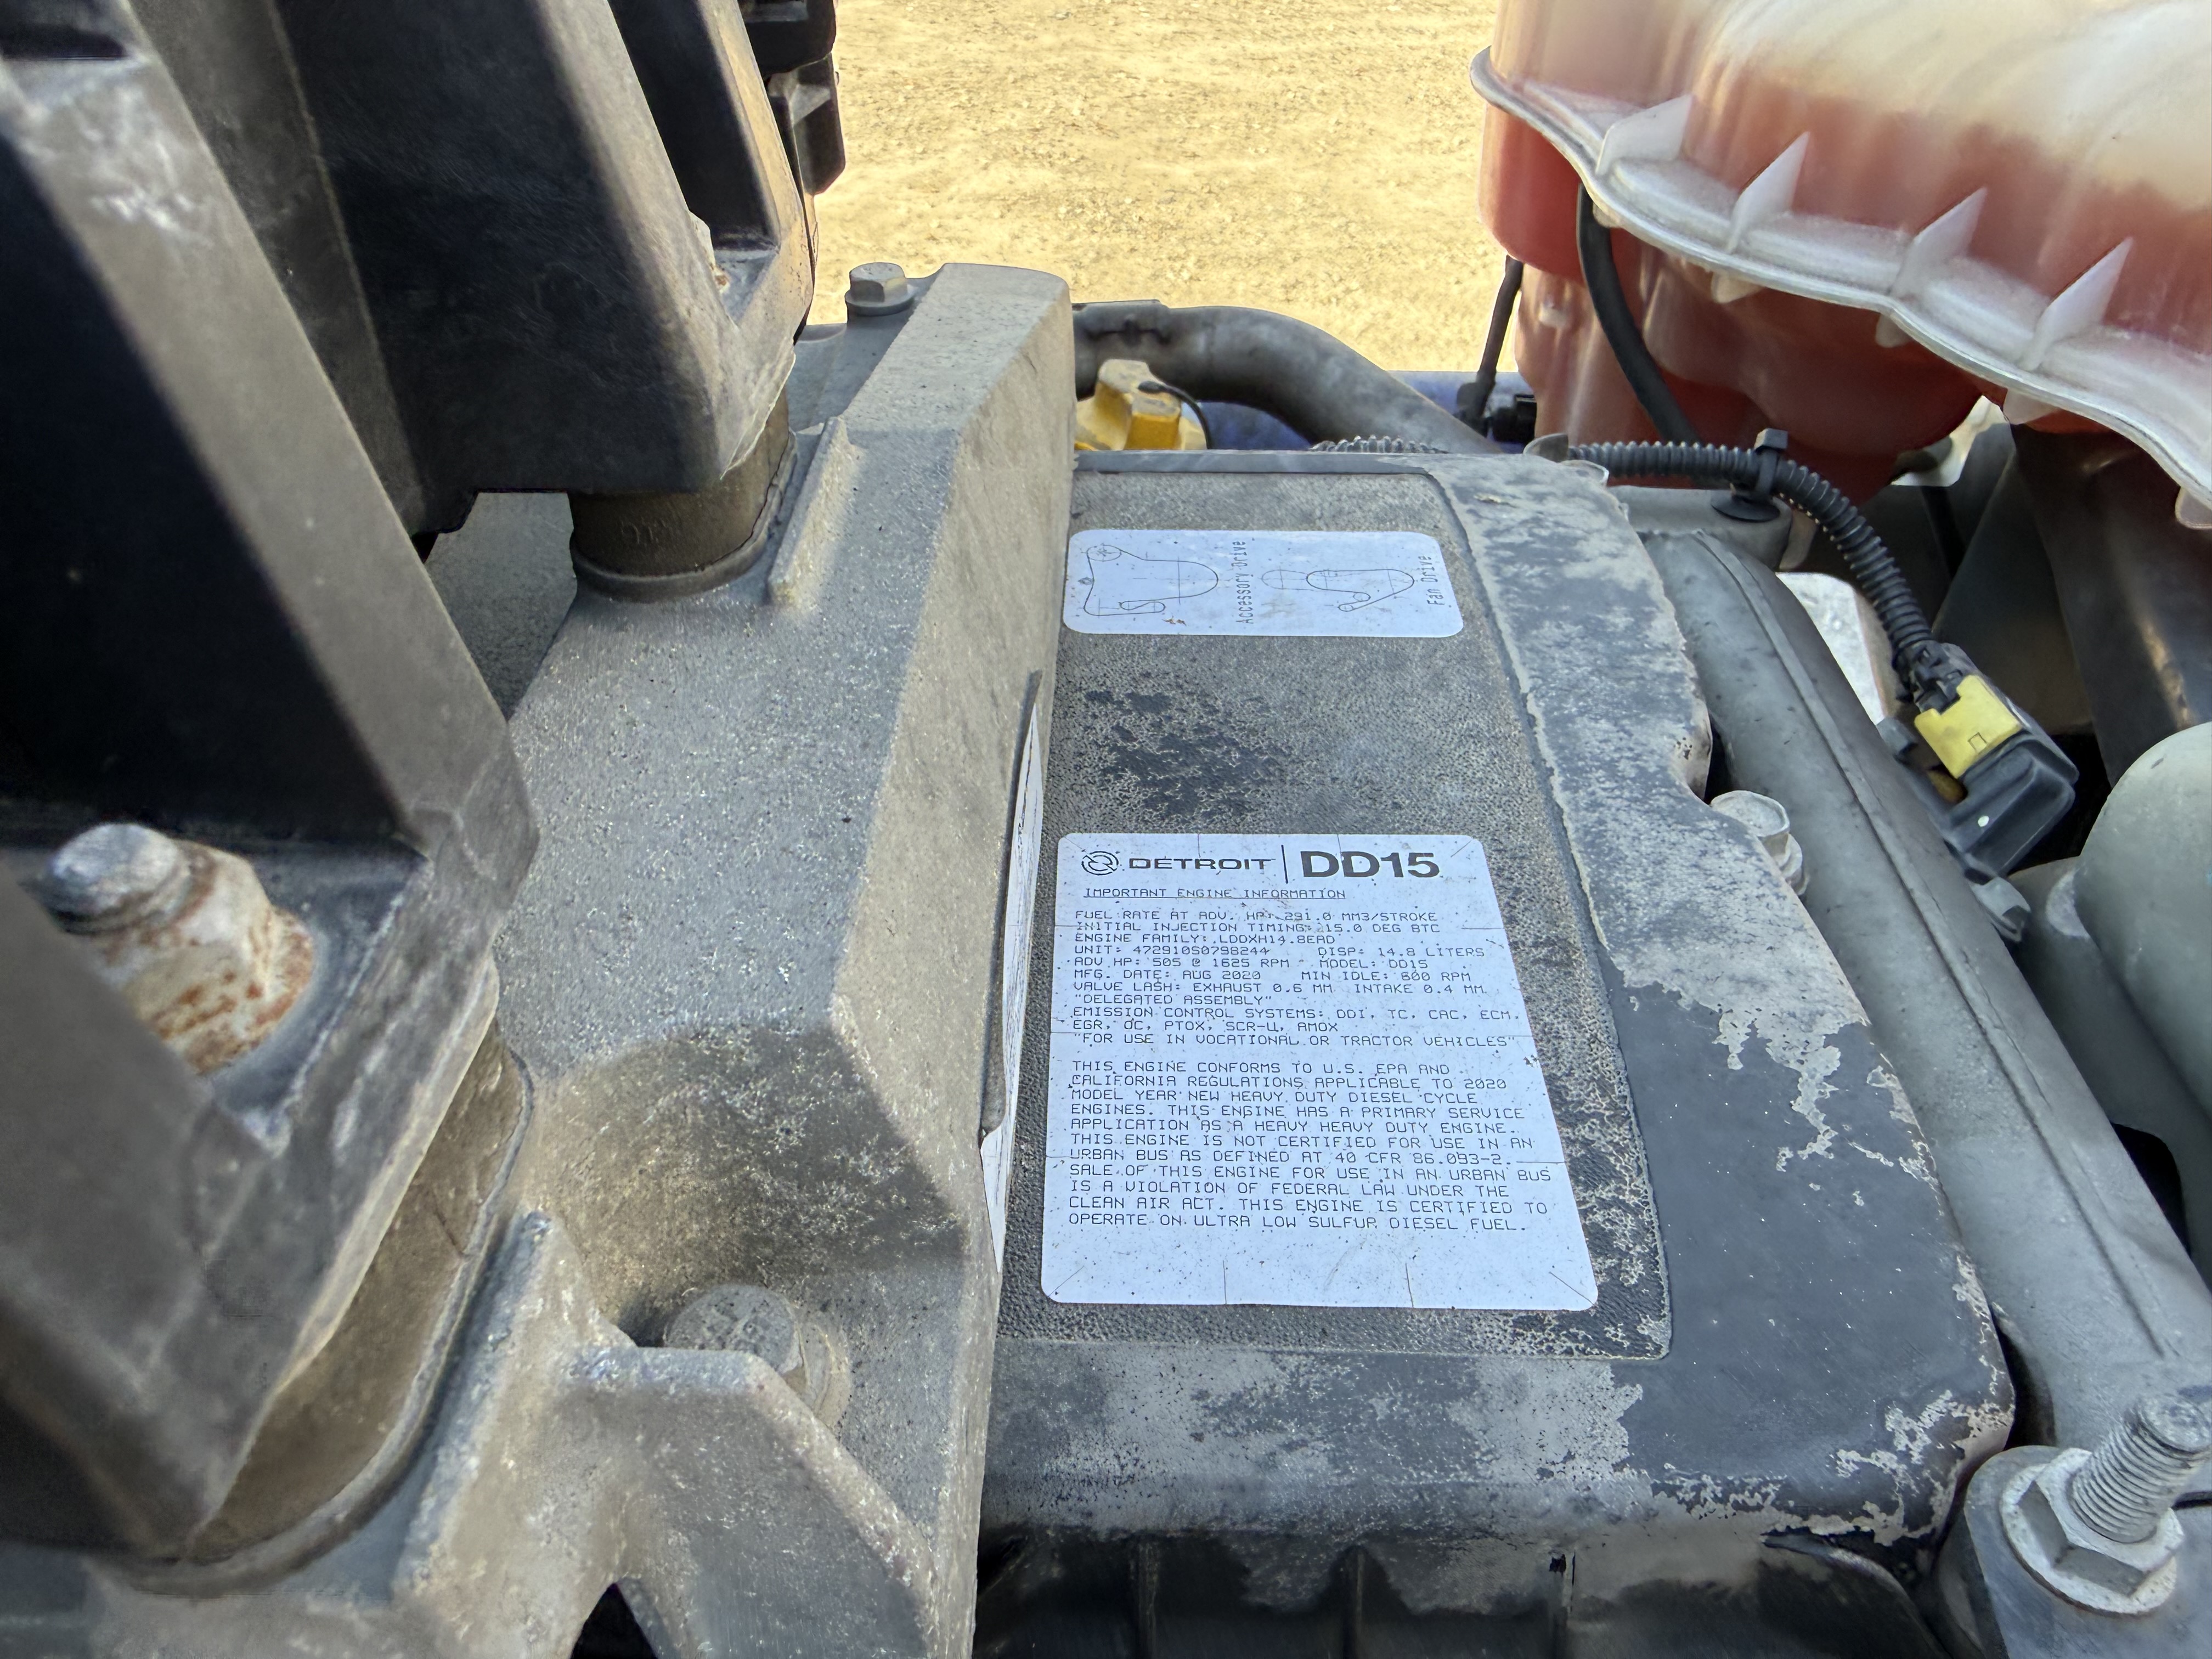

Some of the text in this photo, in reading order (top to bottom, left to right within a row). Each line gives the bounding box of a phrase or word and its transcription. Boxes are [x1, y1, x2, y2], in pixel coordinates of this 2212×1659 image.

[1231, 541, 1254, 624] Accessory Drive
[1418, 555, 1445, 605] Fan Drive
[1129, 858, 1273, 870] DETROIT
[1300, 851, 1440, 878] DD15
[1085, 888, 1345, 899] IMPORTANT ENGINE INFORMATION
[1075, 910, 1113, 919] FUEL
[1123, 911, 1160, 919] RATE
[1170, 911, 1188, 920] AT
[1199, 911, 1234, 920] ADV.
[1285, 912, 1331, 921] 291.0
[1342, 912, 1438, 921] MM3/STROKE
[1076, 922, 1141, 930] INITIAL
[1154, 922, 1237, 931] INJECTION
[1326, 924, 1362, 933] 15.0
[1373, 924, 1401, 933] DEG
[1410, 924, 1440, 933] BTC
[1075, 933, 1335, 944] ENGINE FAMILY: LDDXH14.8EAD
[1075, 945, 1121, 954] UNIT:
[1318, 947, 1364, 956] DISP:
[1378, 947, 1416, 956] 14.8
[1426, 947, 1485, 957] LITERS
[1074, 957, 1428, 968] ADV HP: 505 @ 1625 RPM MODEL: DD15
[1074, 969, 1110, 979] MFG.
[1124, 970, 1169, 979] DATE:
[1183, 970, 1211, 979] AUG
[1222, 970, 1261, 980] 2020
[1301, 971, 1331, 980] MIN
[1342, 972, 1388, 981] IDLE:
[1441, 972, 1471, 981] RPM
[1074, 981, 1123, 991] VALVE
[1133, 982, 1180, 991] LASH:
[1193, 983, 1262, 992] EXHAUST
[1273, 984, 1302, 992] 0.6
[1313, 984, 1333, 993] MM
[1355, 984, 1413, 994] INTAKE
[1424, 984, 1453, 994] 0.4
[1075, 994, 1272, 1006] "DELEGATED ASSEMBLY"
[1074, 1007, 1519, 1020] EMISSION CONTROL SYSTEMS: DDI, TC, CAC, ECM,
[1073, 1020, 1338, 1032] EGR, OC, PTOX, SCR-U, AMOX
[1074, 1032, 1515, 1047] "FOR USE IN VOCATIONAL OR TRACTOR VEHICLES"
[1072, 1060, 1450, 1075] THIS ENGINE CONFORMS TO U.S. EPA AND
[1071, 1075, 1507, 1090] CALIFORNIA REGULATIONS APPLICABLE TO 2020
[1071, 1089, 1478, 1104] MODEL YEAR NEW HEAVY DUTY DIESEL CYCLE
[1071, 1104, 1525, 1119] ENGINES. THIS ENGINE HAS A PRIMARY SERVICE
[1071, 1119, 1515, 1134] APPLICATION AS A HEAVY HEAVY DUTY ENGINE.
[1070, 1133, 1533, 1149] THIS ENGINE IS NOT CERTIFIED FOR USE IN AN
[1070, 1149, 1511, 1165] URBAN BUS AS DEFINED AT 40 CFR 86.093-2.
[1070, 1164, 1551, 1181] SALE OF THIS ENGINE FOR USE IN AN URBAN BUS
[1071, 1180, 1509, 1197] IS A VIOLATION OF FEDERAL LAW UNDER THE
[1069, 1197, 1547, 1214] CLEAN AIR ACT. THIS ENGINE IS CERTIFIED TO
[1069, 1214, 1526, 1231] OPERATE ON ULTRA LOW SULFUR DIESEL FUEL.
